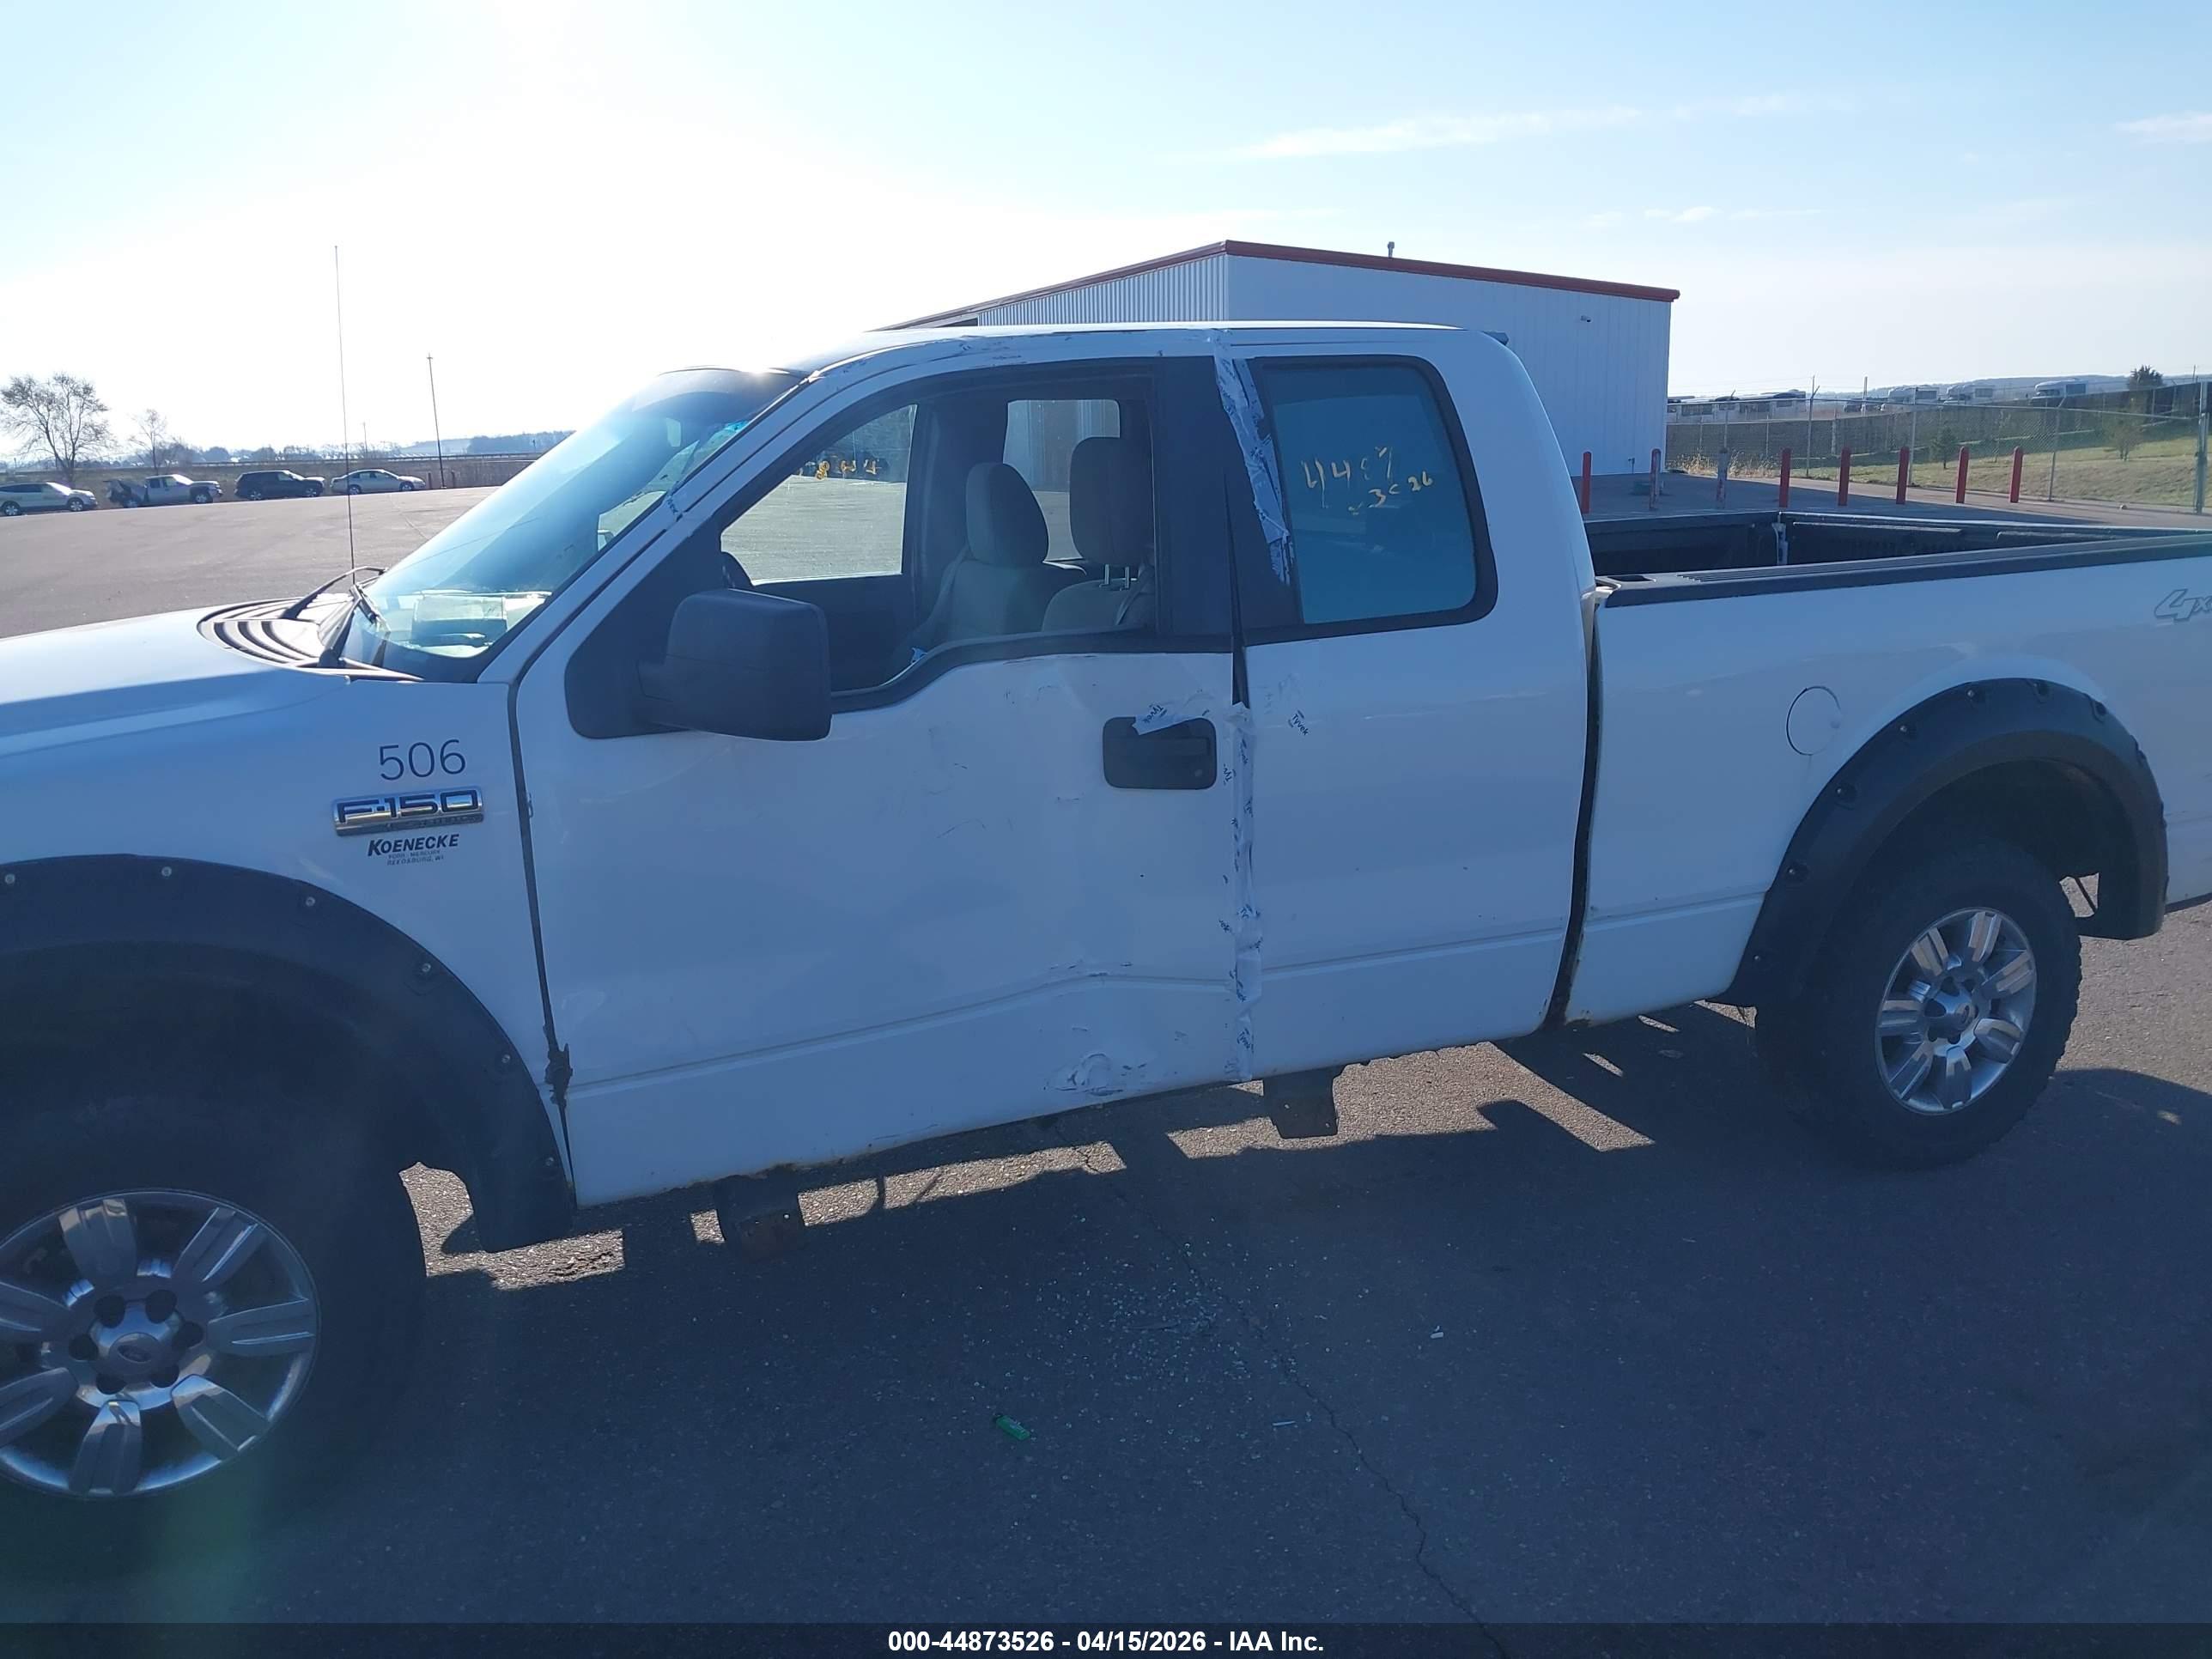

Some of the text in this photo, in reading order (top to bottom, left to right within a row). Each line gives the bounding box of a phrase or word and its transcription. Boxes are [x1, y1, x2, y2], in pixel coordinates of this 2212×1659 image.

[2154, 588, 2212, 622] 4x
[1291, 714, 1310, 736] Tyvek
[379, 738, 466, 781] 506
[336, 788, 479, 824] F-150
[367, 833, 460, 857] KOENECKE
